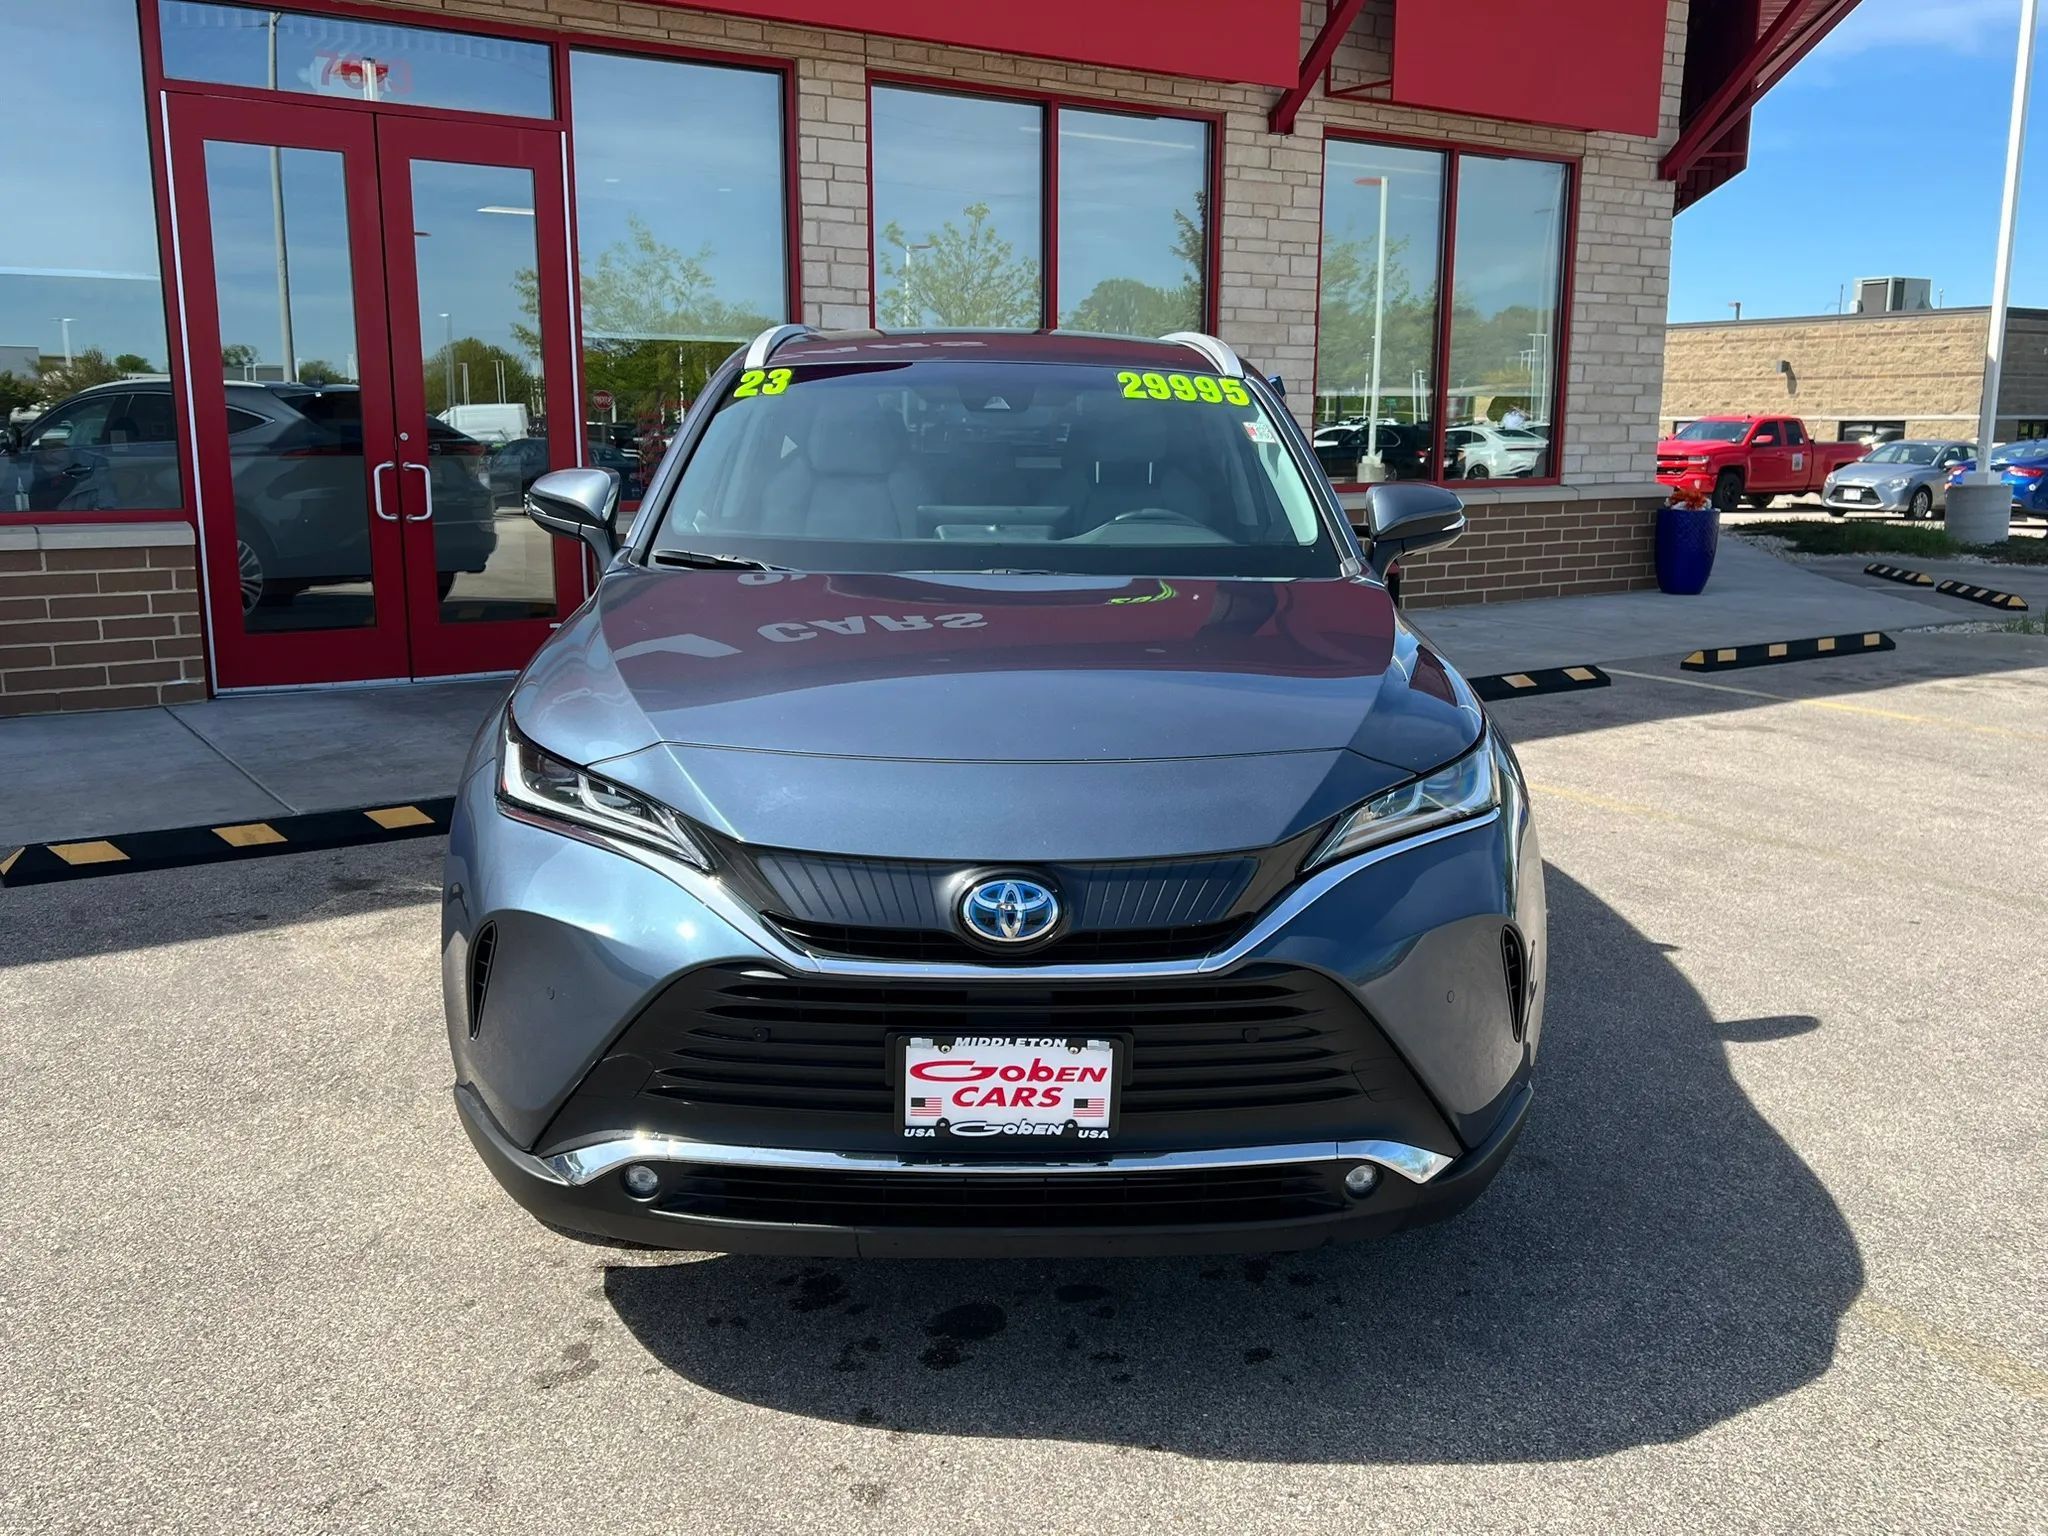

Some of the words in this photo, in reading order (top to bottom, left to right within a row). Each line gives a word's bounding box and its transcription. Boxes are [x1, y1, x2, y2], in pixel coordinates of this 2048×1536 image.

[733, 368, 793, 398] 23
[1117, 371, 1250, 406] 29995
[954, 1037, 1067, 1048] MIDDLETON
[952, 1086, 1064, 1107] CARS
[904, 1128, 936, 1138] USA
[1078, 1129, 1109, 1139] USA
